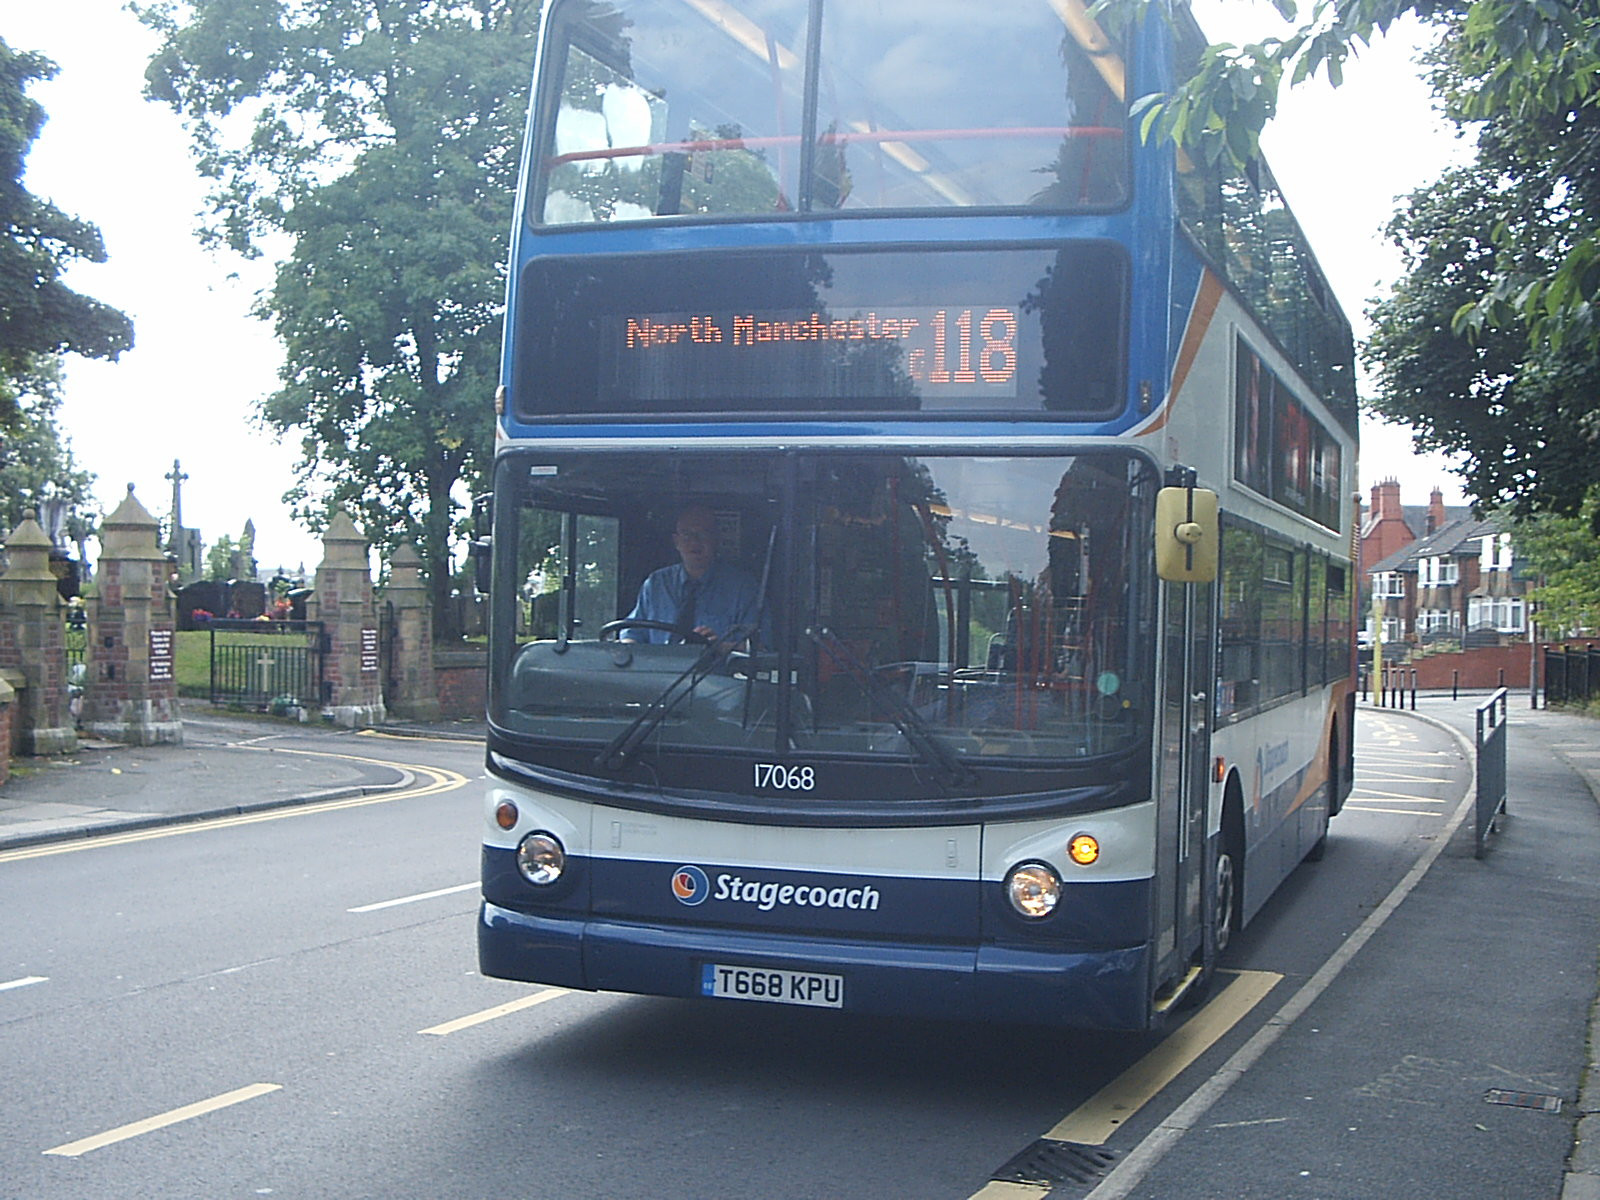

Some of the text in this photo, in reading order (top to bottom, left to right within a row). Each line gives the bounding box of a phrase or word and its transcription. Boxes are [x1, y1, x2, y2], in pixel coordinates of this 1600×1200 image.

[626, 312, 920, 348] North Manchester
[929, 308, 1018, 384] 118
[754, 763, 815, 791] 17068
[714, 874, 880, 911] Stagecoach
[719, 969, 840, 1003] T668 KPU
